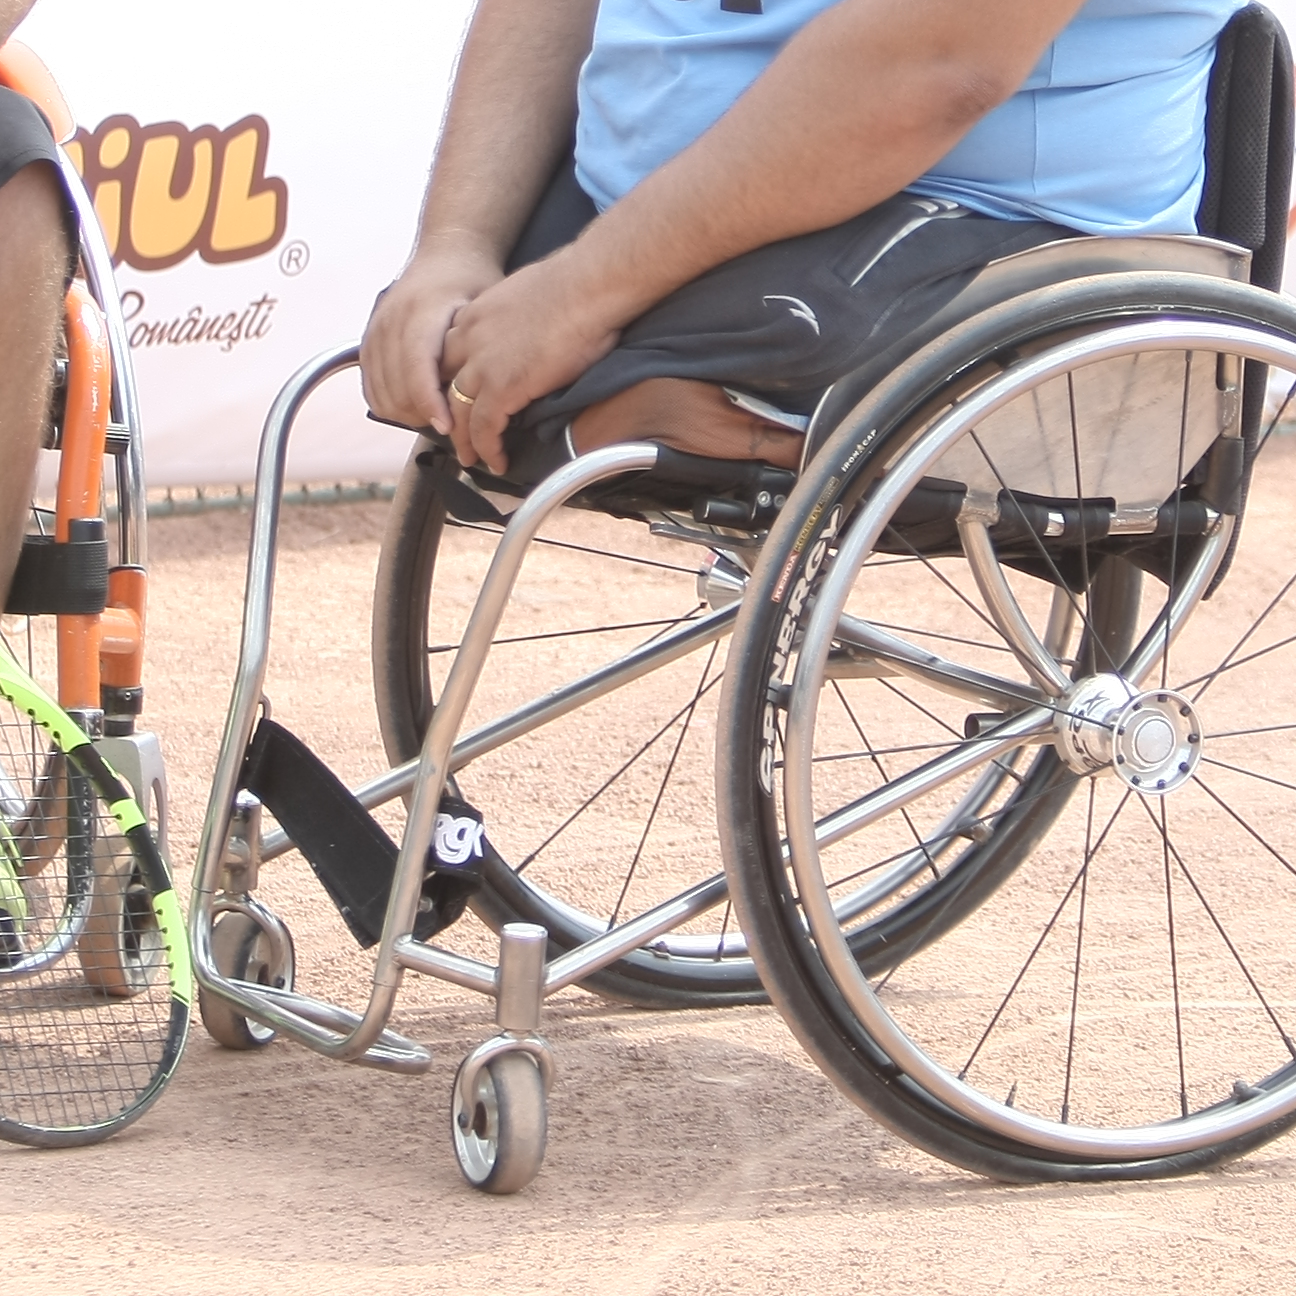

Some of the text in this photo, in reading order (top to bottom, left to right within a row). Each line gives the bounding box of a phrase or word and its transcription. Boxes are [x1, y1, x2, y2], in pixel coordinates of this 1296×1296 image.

[67, 114, 289, 271] iUL
[840, 428, 878, 473] IRON CAP
